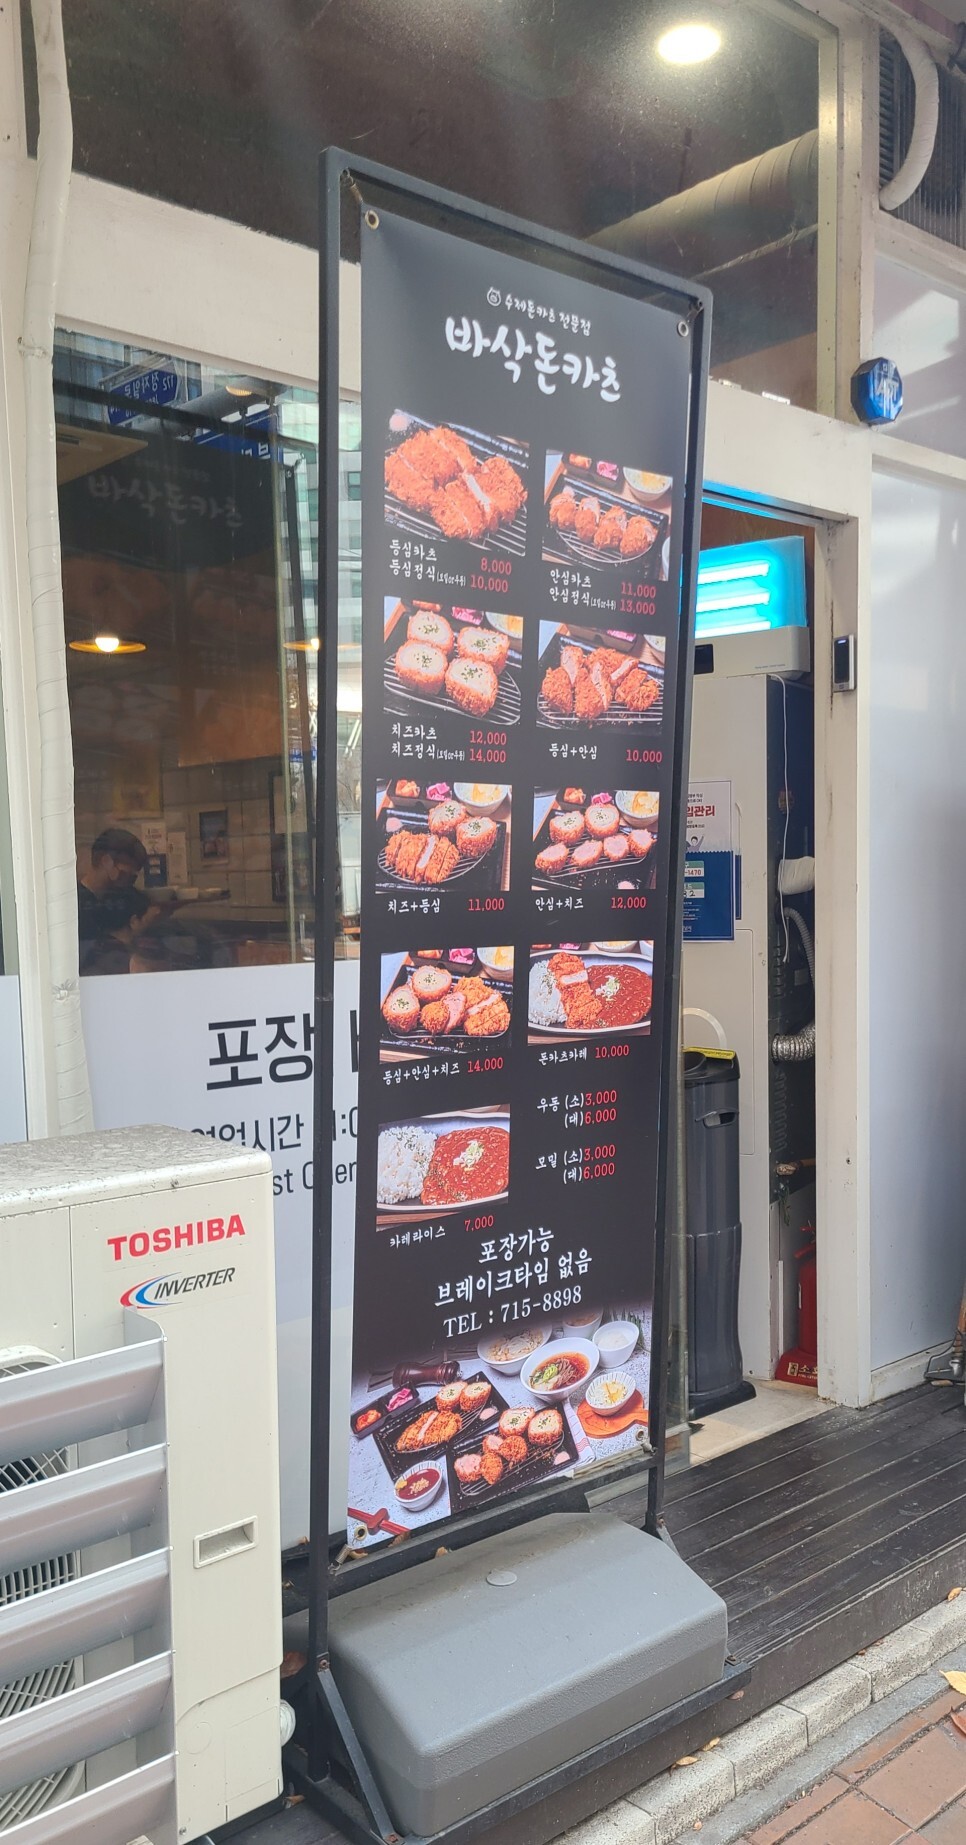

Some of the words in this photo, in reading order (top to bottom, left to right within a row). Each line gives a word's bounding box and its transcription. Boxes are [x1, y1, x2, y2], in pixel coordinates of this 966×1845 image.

[505, 294, 555, 322] 수제돈카츠
[559, 312, 591, 336] 전문점
[445, 316, 621, 402] 바삭돈카츠
[389, 539, 437, 561] 등심카츠
[550, 568, 592, 588] 안심카츠
[621, 581, 657, 598] 11,000
[619, 598, 656, 616] 13,000
[391, 722, 437, 740] 치즈카츠
[469, 730, 507, 746] 12,000
[469, 748, 507, 763] 14,000
[549, 743, 598, 760] 등심+안심
[626, 749, 663, 763] 10,000
[387, 897, 441, 915] 치즈+등심
[468, 898, 505, 912] 11,000
[535, 896, 584, 912] 안심+치즈
[611, 896, 647, 909] 12,000
[206, 1012, 315, 1091] 포장
[538, 1046, 588, 1066] 돈카츠카레
[595, 1044, 630, 1059] 10,000
[382, 1061, 460, 1086] 등심+안심+치즈
[467, 1057, 503, 1073] 14,000
[536, 1096, 560, 1113] 우동
[535, 1152, 557, 1170] 모밀
[107, 1213, 246, 1261] TOSHIBA
[389, 1225, 446, 1249] 카레라이스
[464, 1215, 494, 1232] 7,000
[478, 1227, 554, 1263] 포장가능
[153, 1267, 236, 1300] INVERTER
[434, 1257, 549, 1307] 브레이크타임
[558, 1247, 593, 1280] 없음
[443, 1311, 482, 1338] TEL
[500, 1285, 582, 1323] 715-8898
